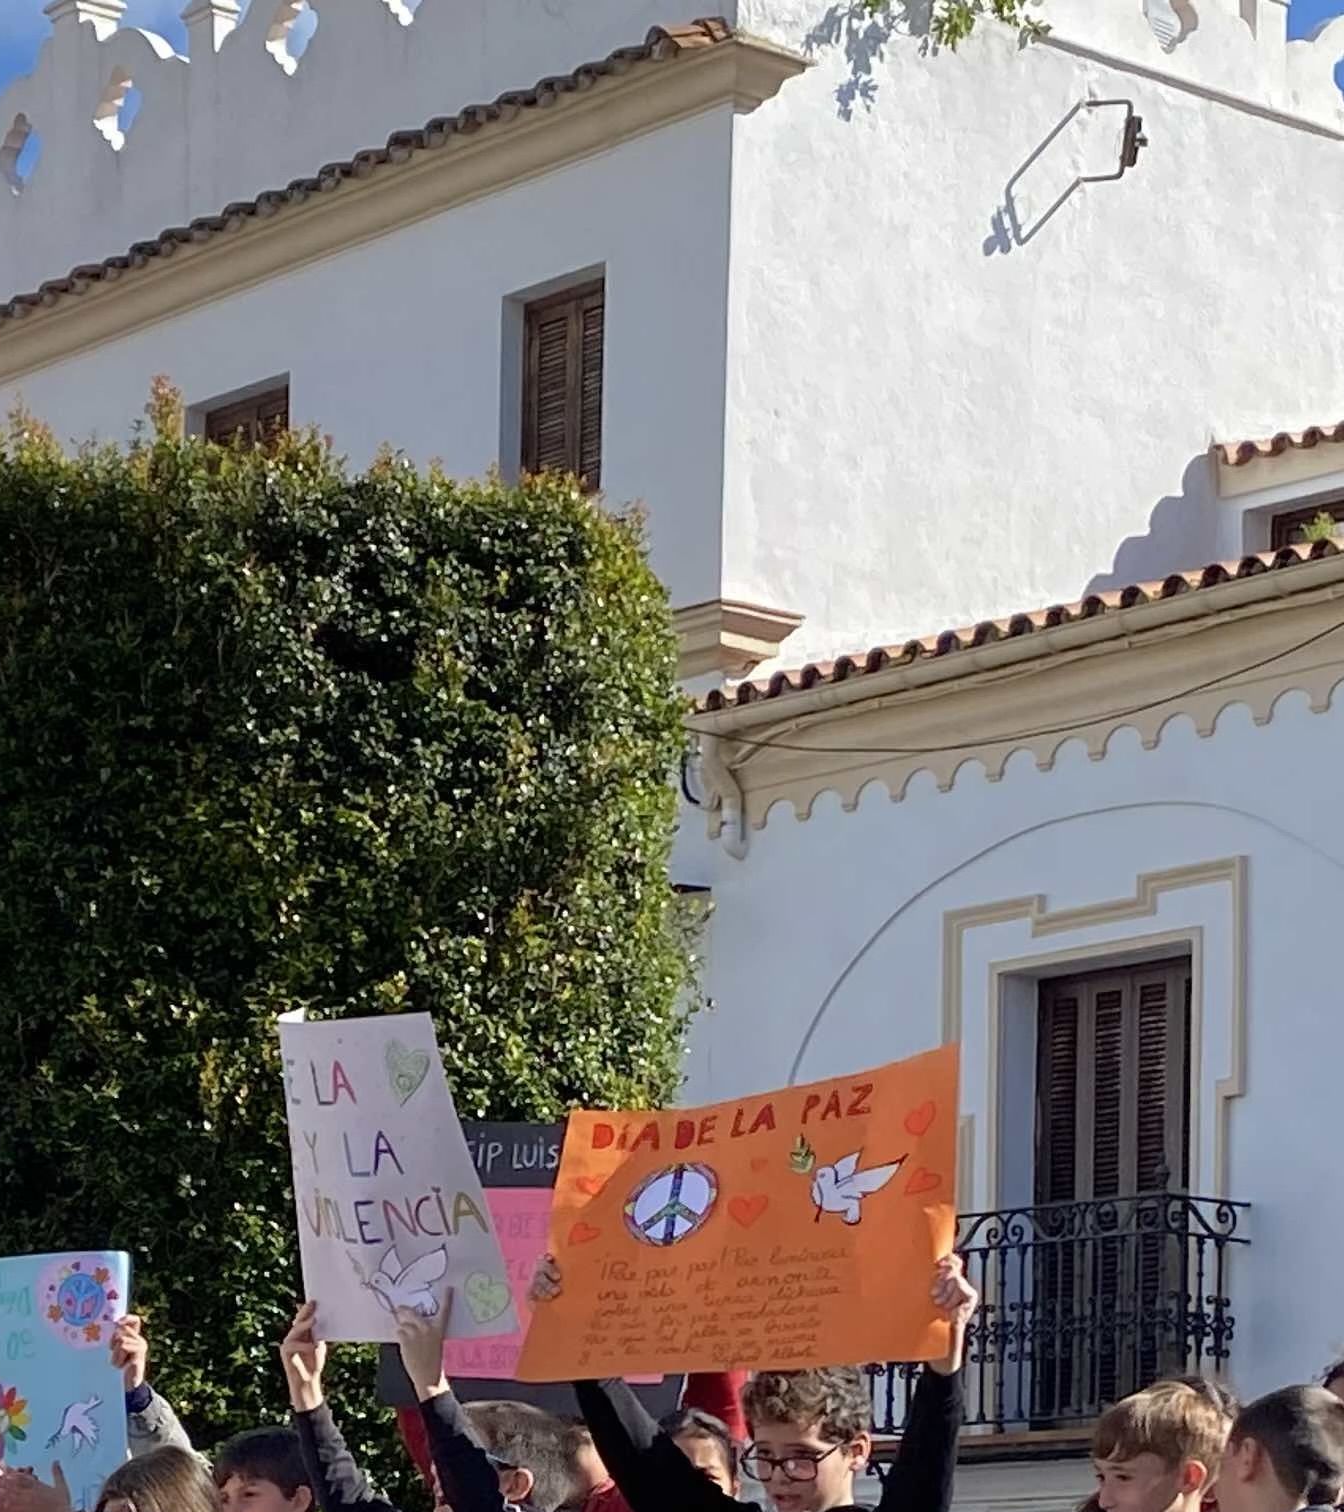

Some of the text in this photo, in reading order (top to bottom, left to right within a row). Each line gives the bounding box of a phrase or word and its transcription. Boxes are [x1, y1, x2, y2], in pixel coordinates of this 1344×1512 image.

[311, 1060, 357, 1106] LA
[674, 1115, 717, 1149] DE
[730, 1102, 777, 1139] LA
[801, 1083, 874, 1124] PAZ
[343, 1130, 405, 1177] LA
